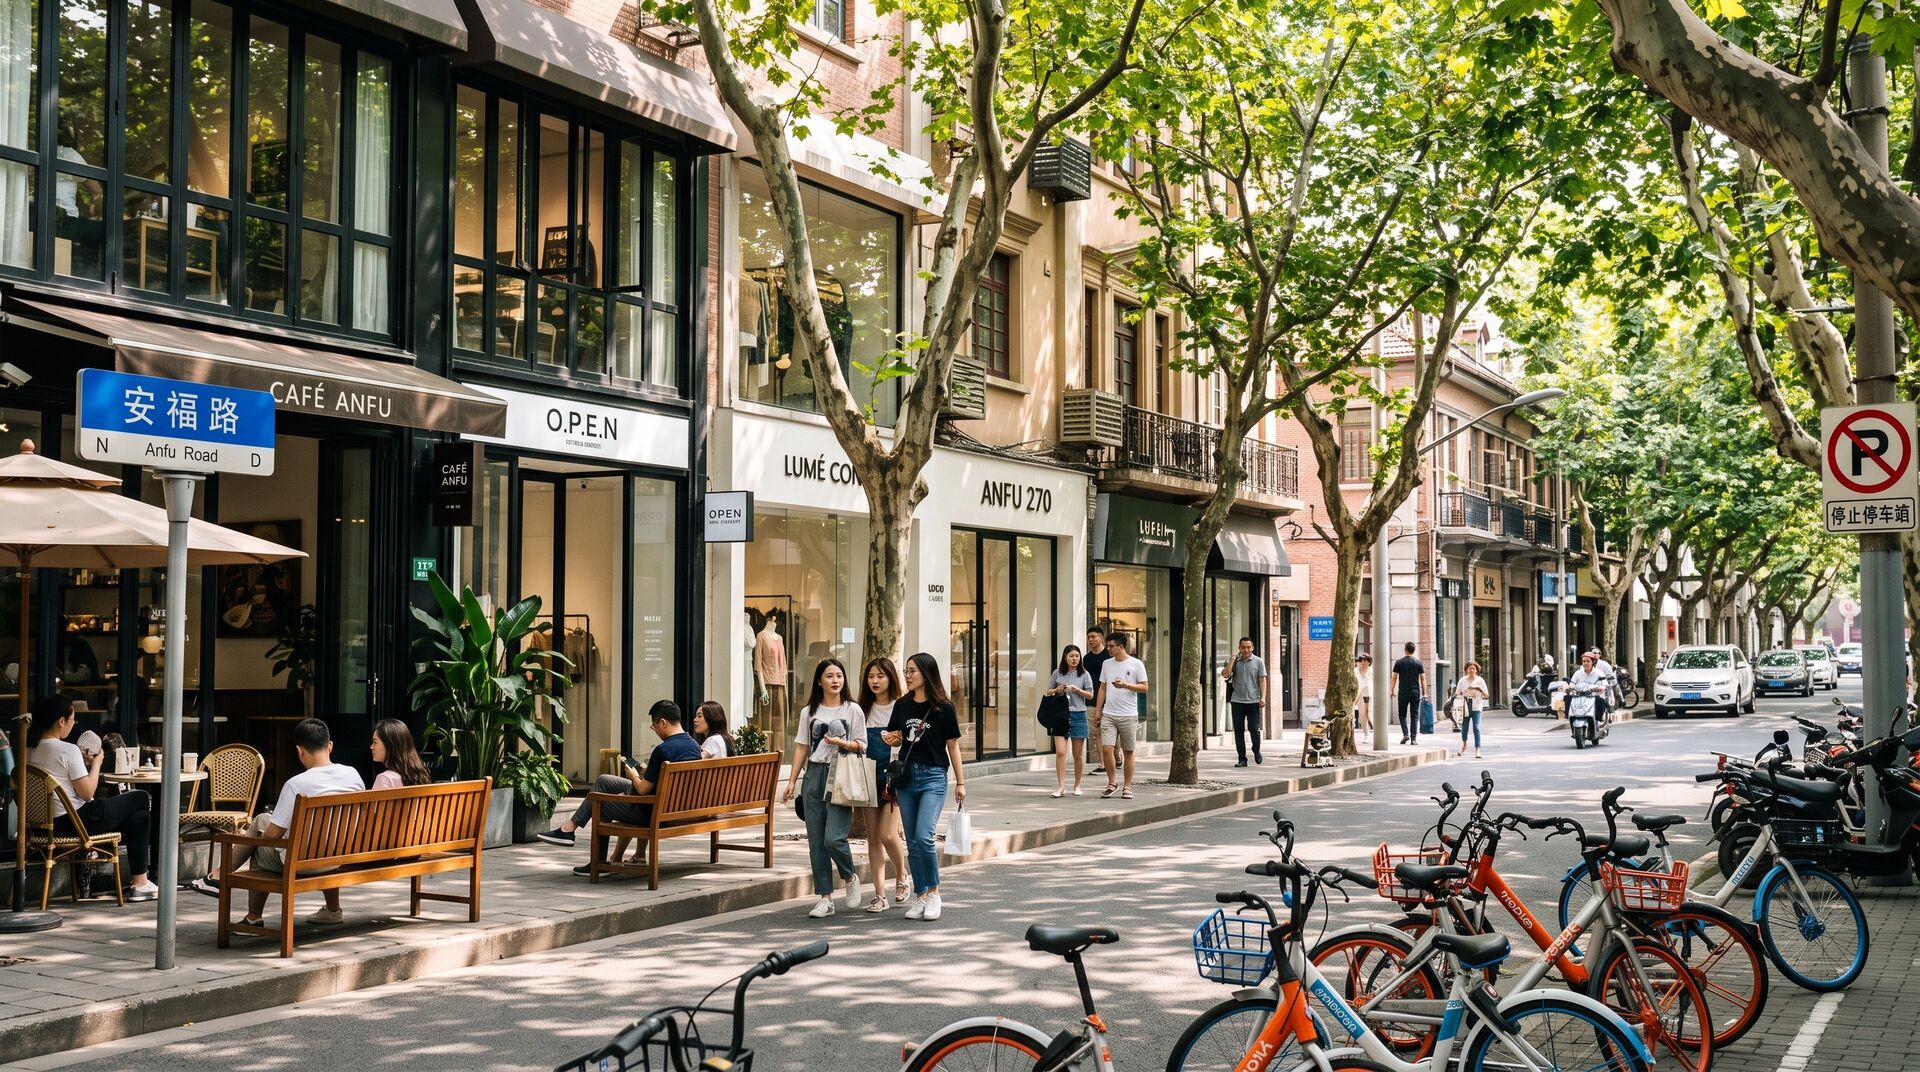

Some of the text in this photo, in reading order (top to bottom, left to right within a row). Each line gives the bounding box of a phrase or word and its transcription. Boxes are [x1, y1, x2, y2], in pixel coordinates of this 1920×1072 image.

[123, 385, 240, 435] 安福路
[270, 381, 391, 418] CAFÉ ANFU
[96, 436, 262, 468] N Anfu Road D
[441, 461, 468, 474] CAFÉ
[441, 475, 468, 486] ANFU
[784, 453, 826, 482] LUMÉ
[980, 479, 1052, 513] ANFU 270
[709, 509, 742, 519] OPEN
